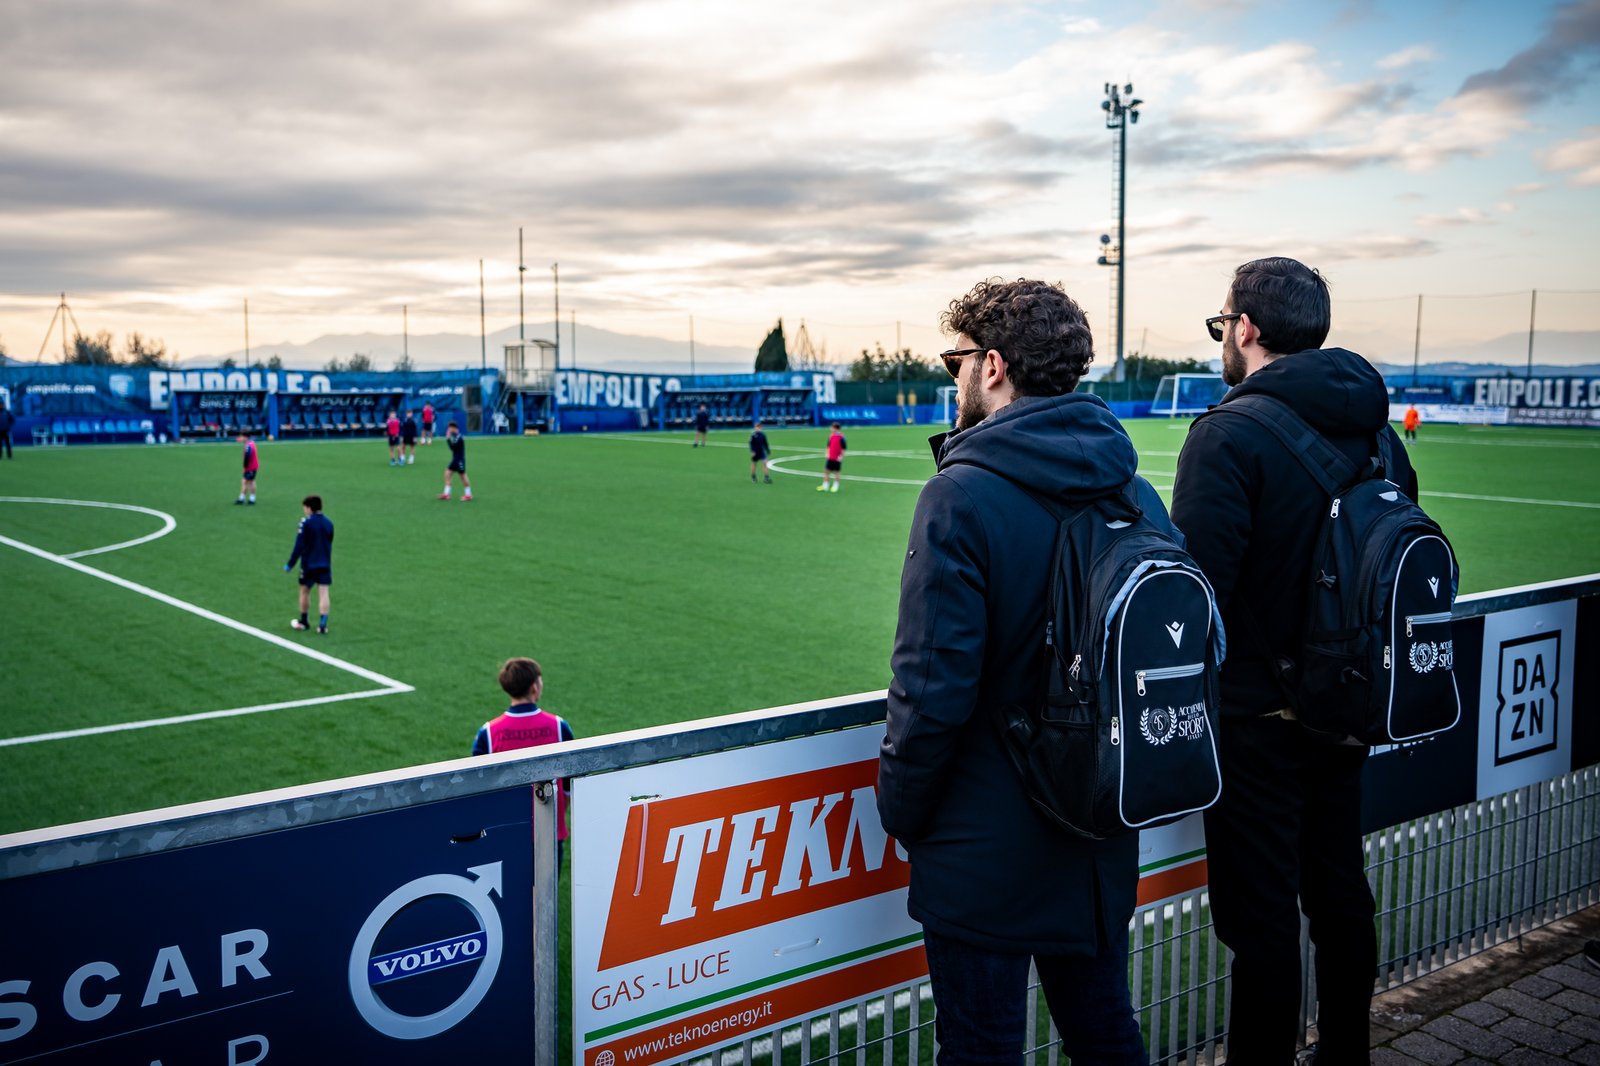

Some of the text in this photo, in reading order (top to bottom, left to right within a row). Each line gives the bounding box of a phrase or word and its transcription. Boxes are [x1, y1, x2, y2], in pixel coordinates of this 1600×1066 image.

[301, 397, 351, 407] EMPOLI
[555, 371, 644, 408] EMPOLI
[1474, 378, 1565, 407] EMPOLI
[1512, 653, 1546, 695] DA
[1178, 716, 1204, 737] SPORT
[1511, 698, 1544, 741] ZN
[660, 785, 909, 926] TEKN
[374, 938, 482, 977] VOLVO
[591, 975, 646, 1011] GAS
[668, 950, 731, 989] LUCE
[624, 1001, 773, 1061] www.teknoenergy.it
